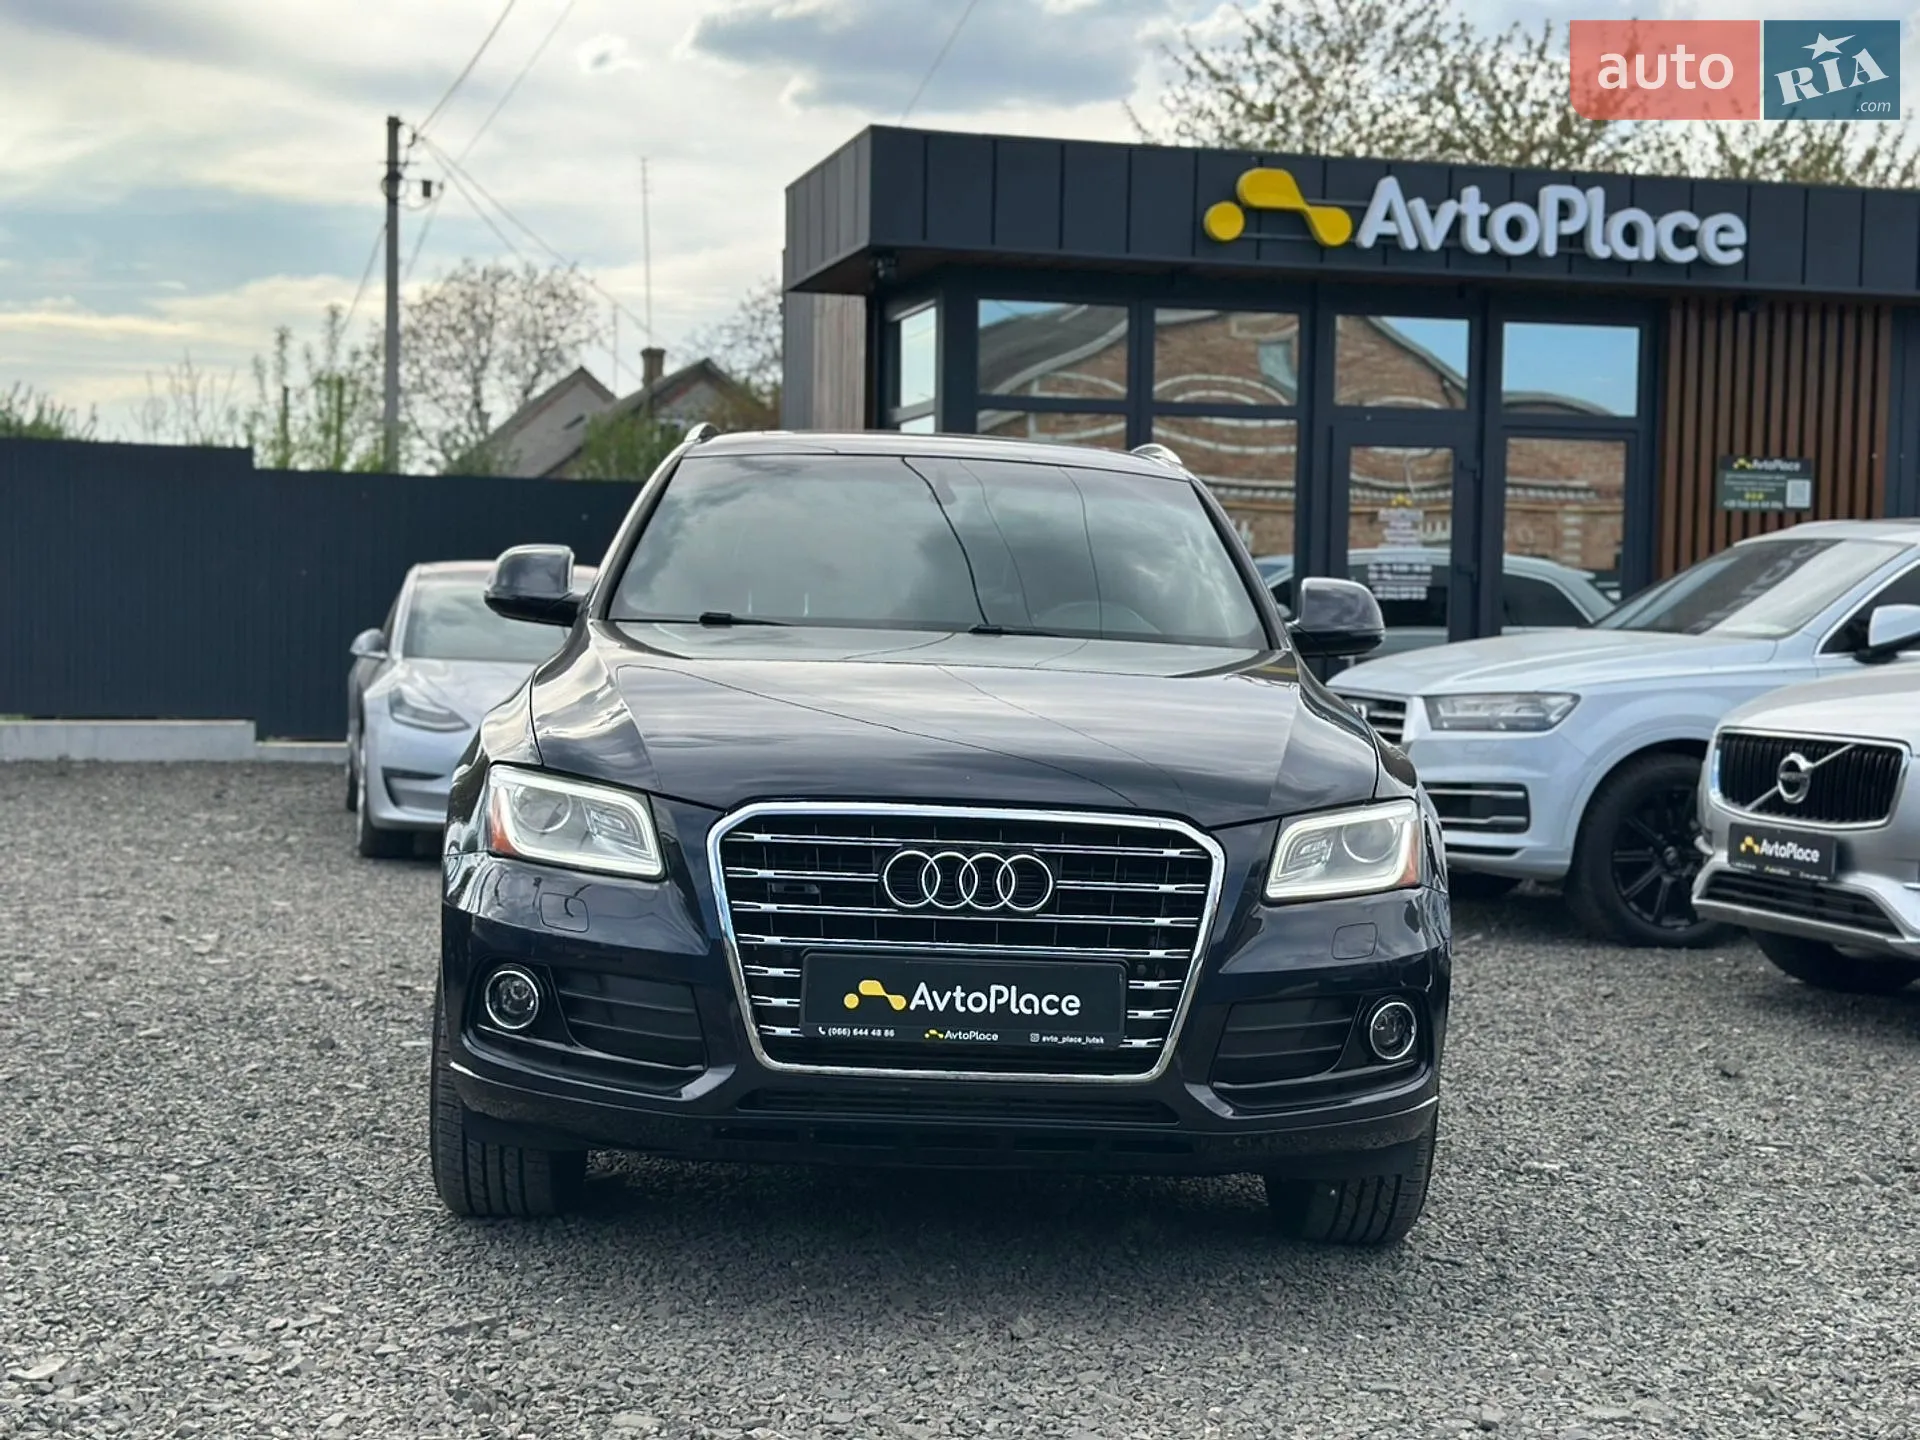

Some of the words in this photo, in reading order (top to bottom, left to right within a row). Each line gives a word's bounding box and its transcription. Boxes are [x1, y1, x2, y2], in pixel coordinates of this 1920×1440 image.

[1355, 175, 1748, 266] AvtoPlace
[1760, 838, 1820, 863] AvtoPlace
[909, 981, 1082, 1016] AvtoPlace
[944, 1030, 999, 1041] AvtoPlace
